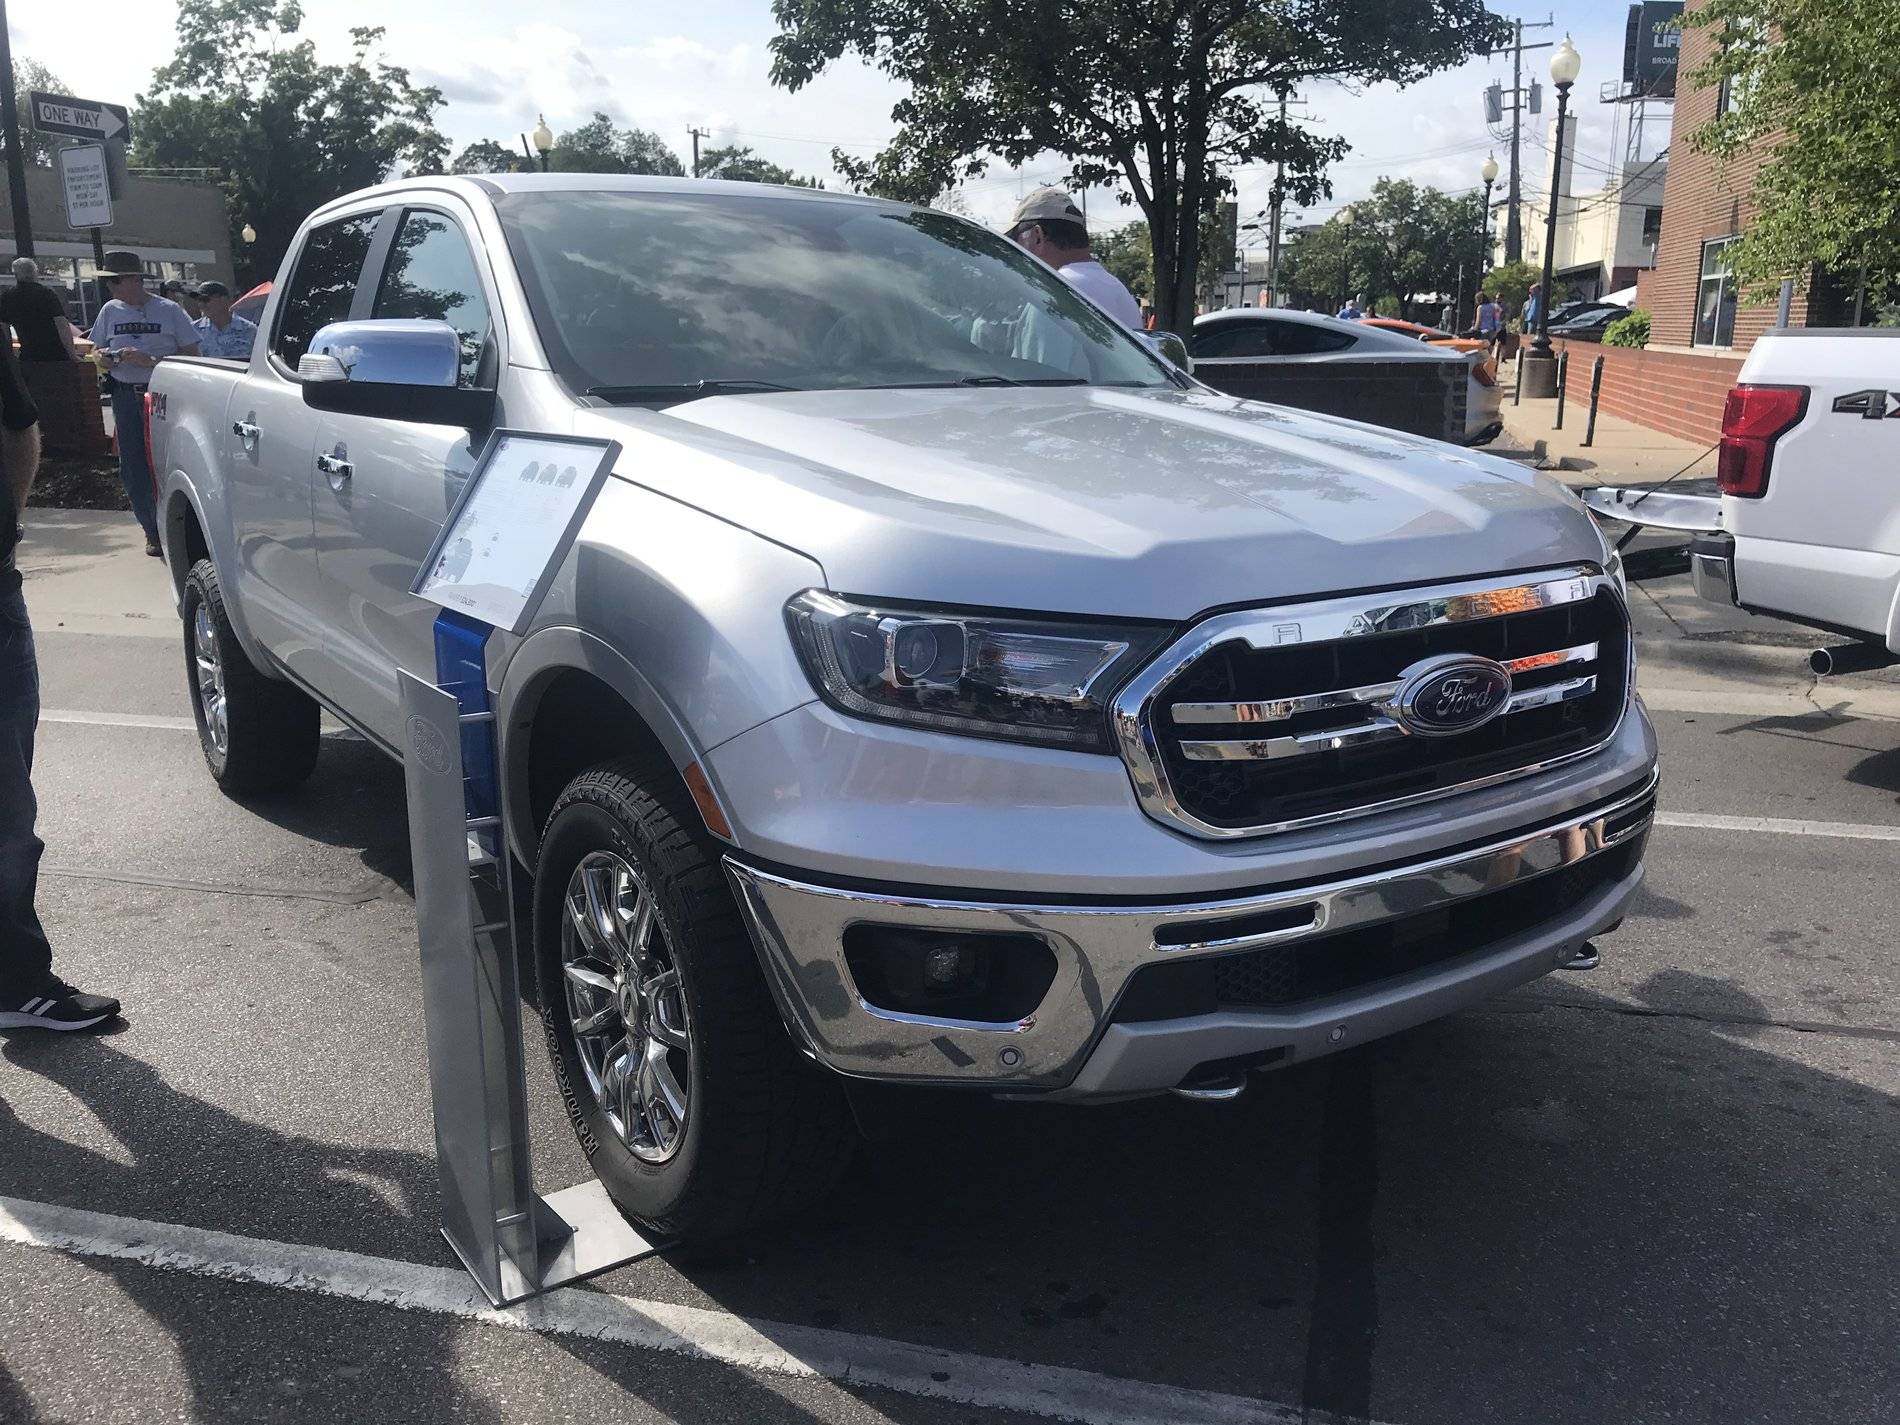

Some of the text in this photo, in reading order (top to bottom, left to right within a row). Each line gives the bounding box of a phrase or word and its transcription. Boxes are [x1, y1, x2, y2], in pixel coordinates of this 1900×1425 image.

[43, 104, 100, 128] ONE WAY
[1436, 676, 1493, 716] Ford
